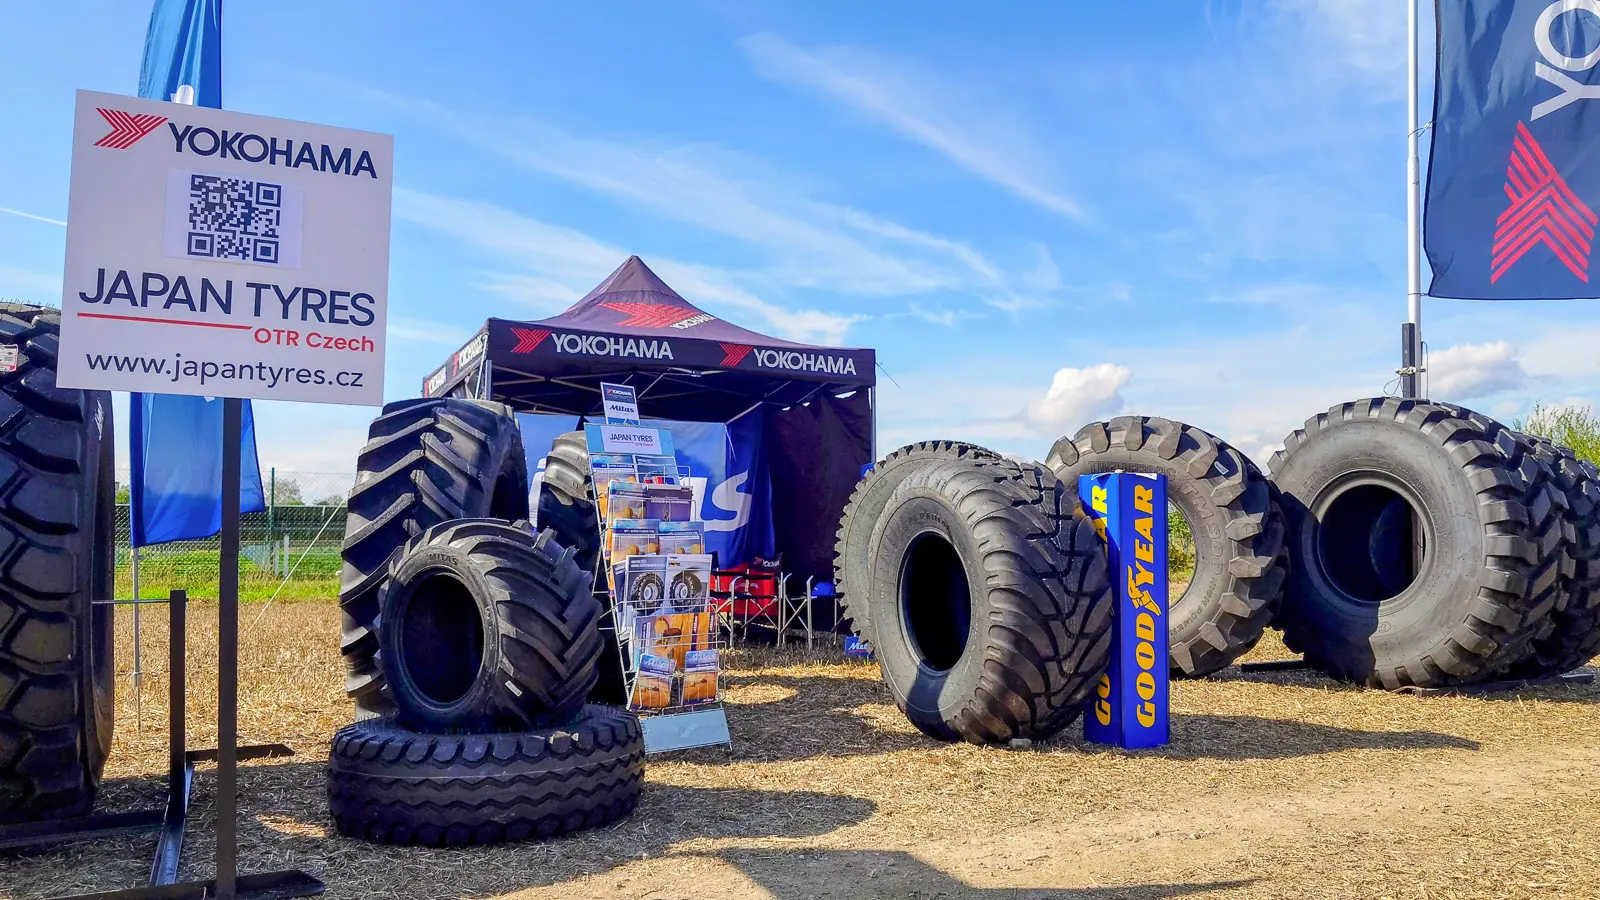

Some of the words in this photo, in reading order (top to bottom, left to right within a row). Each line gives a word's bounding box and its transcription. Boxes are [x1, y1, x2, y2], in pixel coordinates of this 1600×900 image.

[168, 122, 378, 179] YOKOHAMA
[79, 267, 233, 315] JAPAN
[246, 281, 375, 327] TYRES
[254, 327, 300, 347] OTR
[305, 331, 375, 353] Czech
[551, 333, 674, 360] YOKOHAMA
[86, 352, 364, 389] www.japantyres.cz
[753, 348, 857, 376] YOKOHAMA
[609, 404, 635, 413] Mitas
[610, 433, 632, 441] JAPAN
[632, 434, 653, 443] TYRES
[429, 553, 459, 566] MITAS
